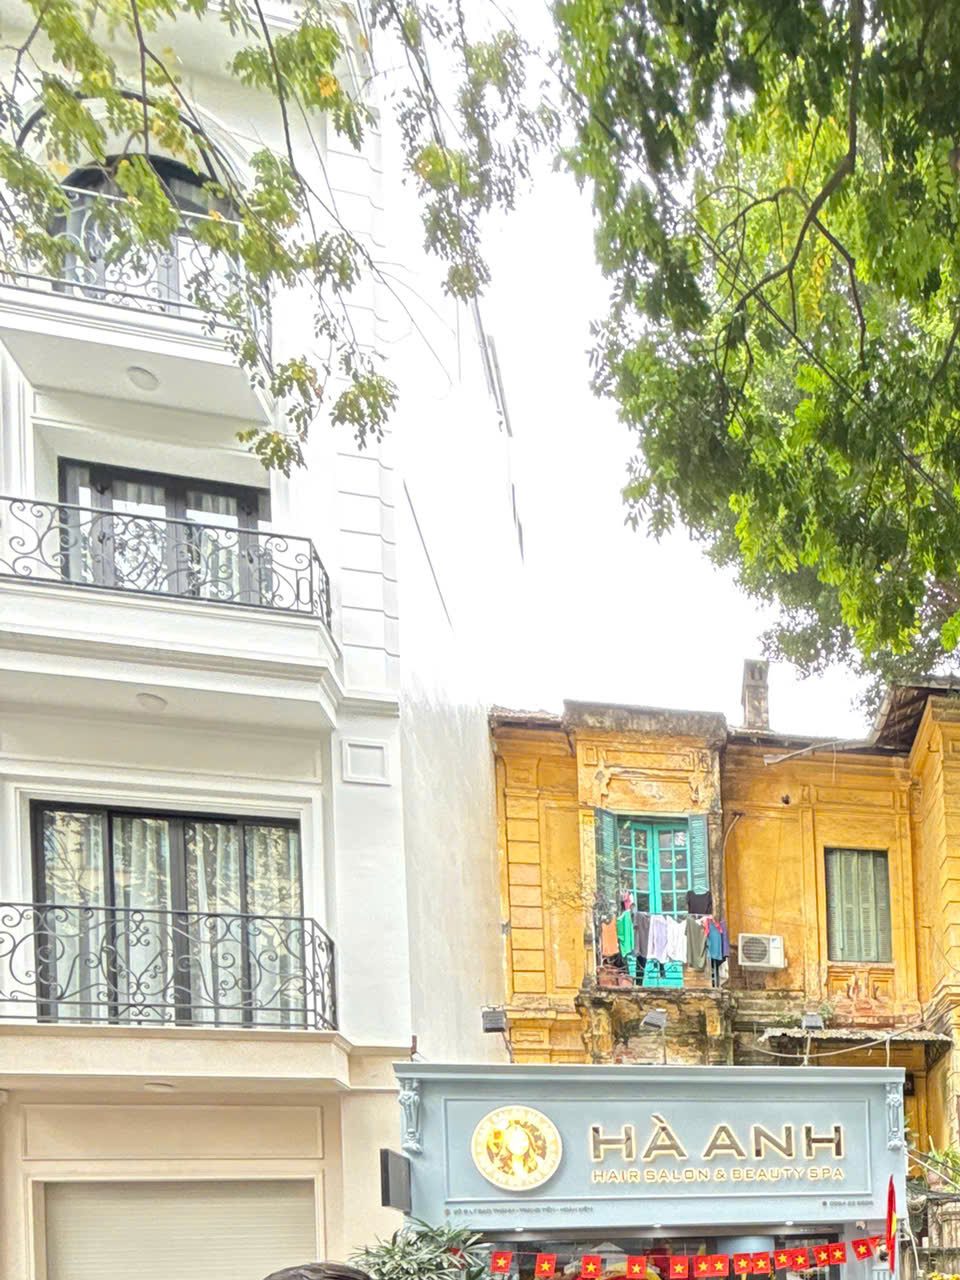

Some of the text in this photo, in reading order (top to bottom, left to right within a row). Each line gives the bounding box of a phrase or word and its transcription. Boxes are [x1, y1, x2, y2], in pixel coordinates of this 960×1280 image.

[591, 1113, 688, 1160] HÀ
[703, 1125, 843, 1159] ANH
[593, 1167, 844, 1182] HAIR SALON & BEAUTY SPA
